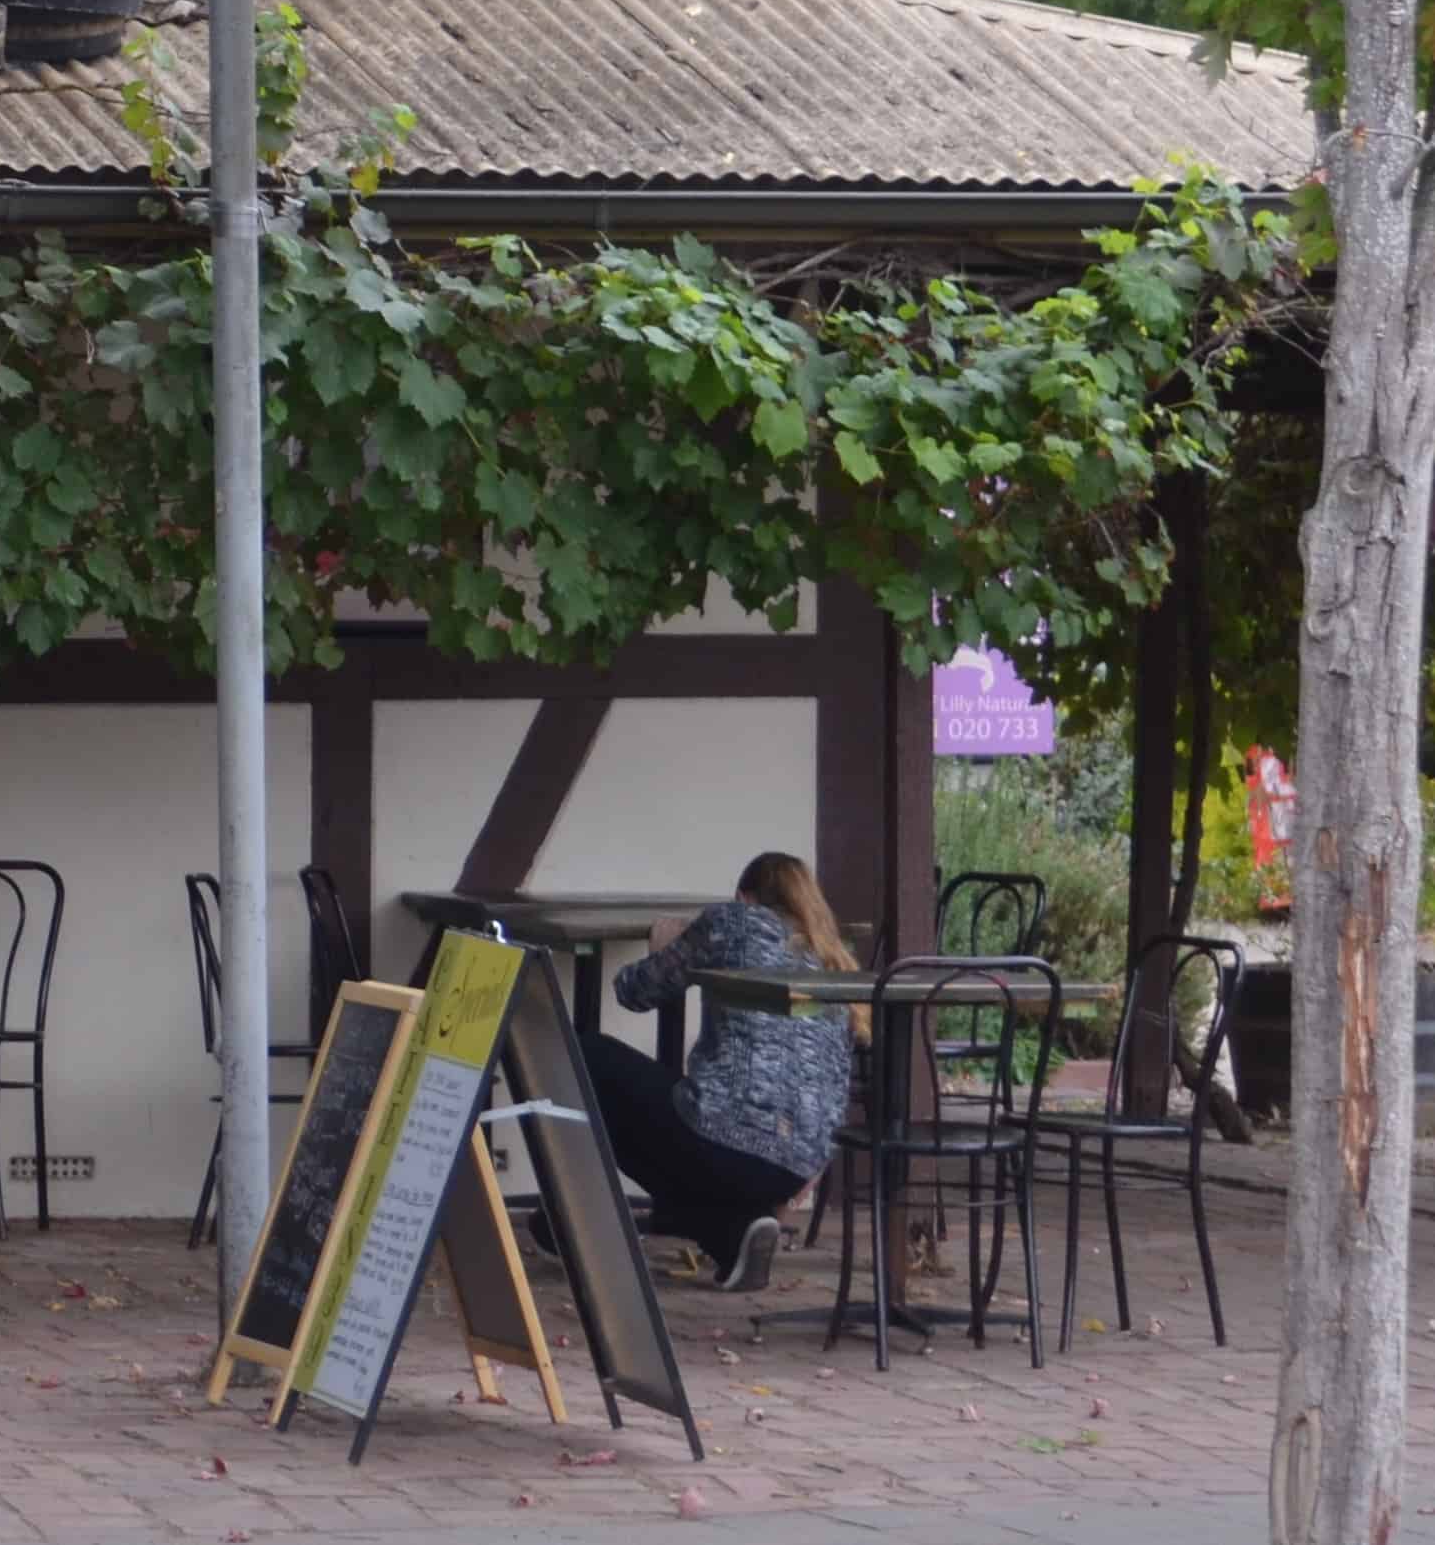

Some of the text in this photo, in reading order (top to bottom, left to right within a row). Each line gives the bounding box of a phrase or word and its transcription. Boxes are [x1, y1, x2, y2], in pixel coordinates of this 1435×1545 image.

[940, 694, 971, 713] Lilly
[948, 718, 991, 740] 020
[1000, 718, 1039, 740] 733
